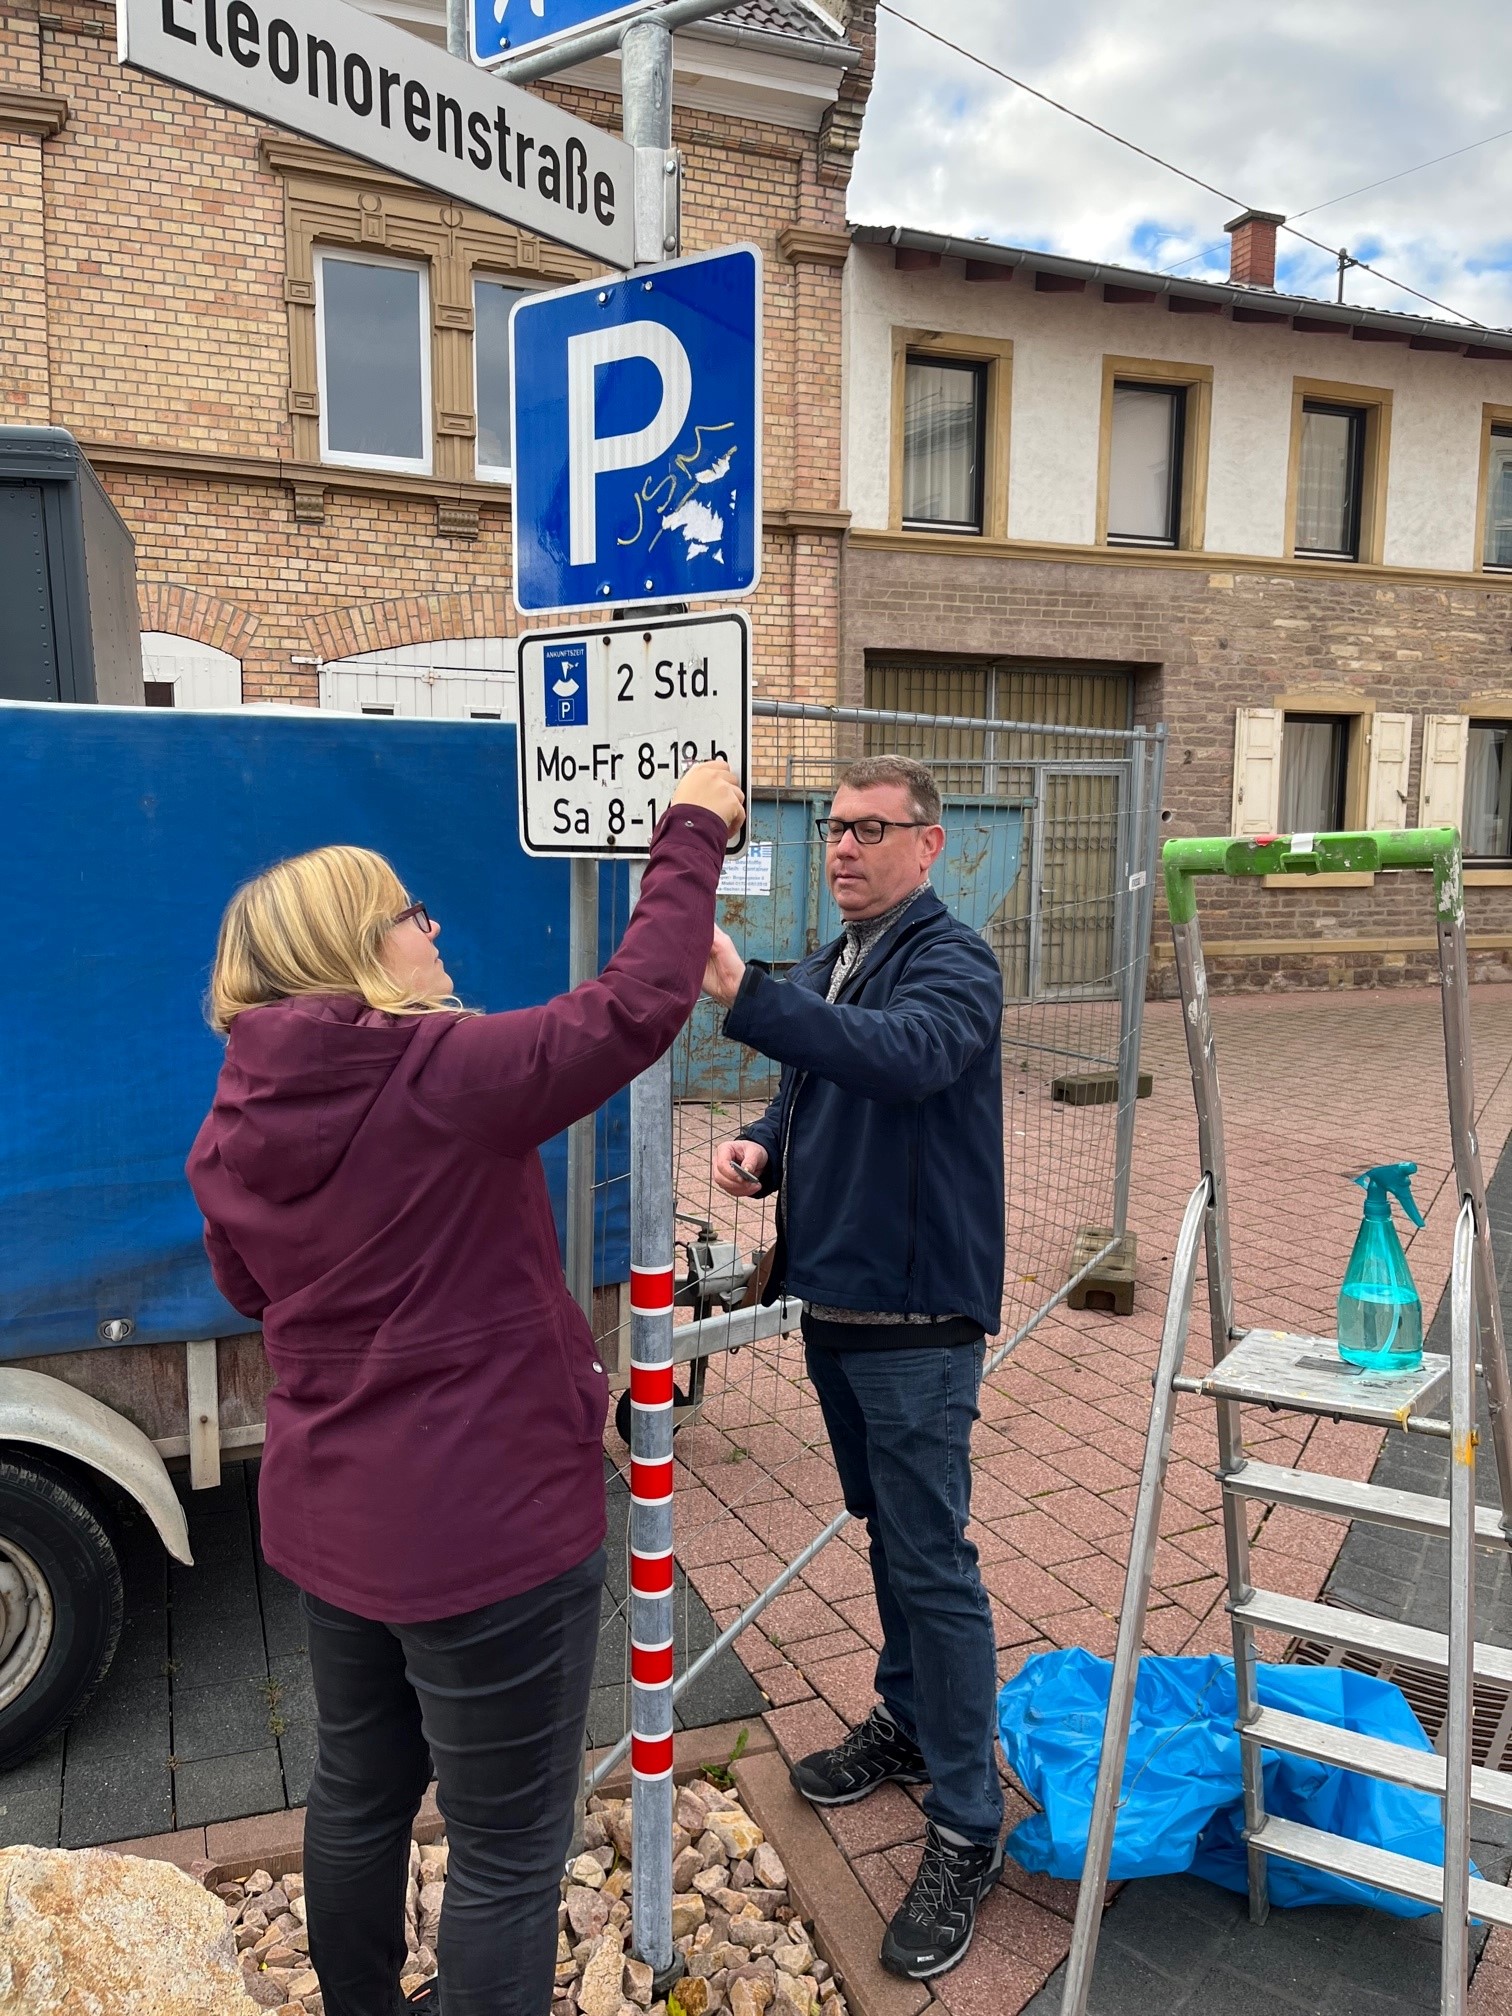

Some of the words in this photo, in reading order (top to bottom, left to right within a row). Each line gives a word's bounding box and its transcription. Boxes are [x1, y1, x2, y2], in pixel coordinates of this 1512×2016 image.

[567, 320, 692, 566] P
[545, 648, 585, 659] ANKUNFTSZEIT
[617, 663, 634, 701] 2
[654, 657, 718, 699] Std.
[561, 701, 571, 719] P
[536, 743, 624, 782] Mo-Fr
[552, 797, 590, 835] Sa
[607, 797, 671, 835] 8-1
